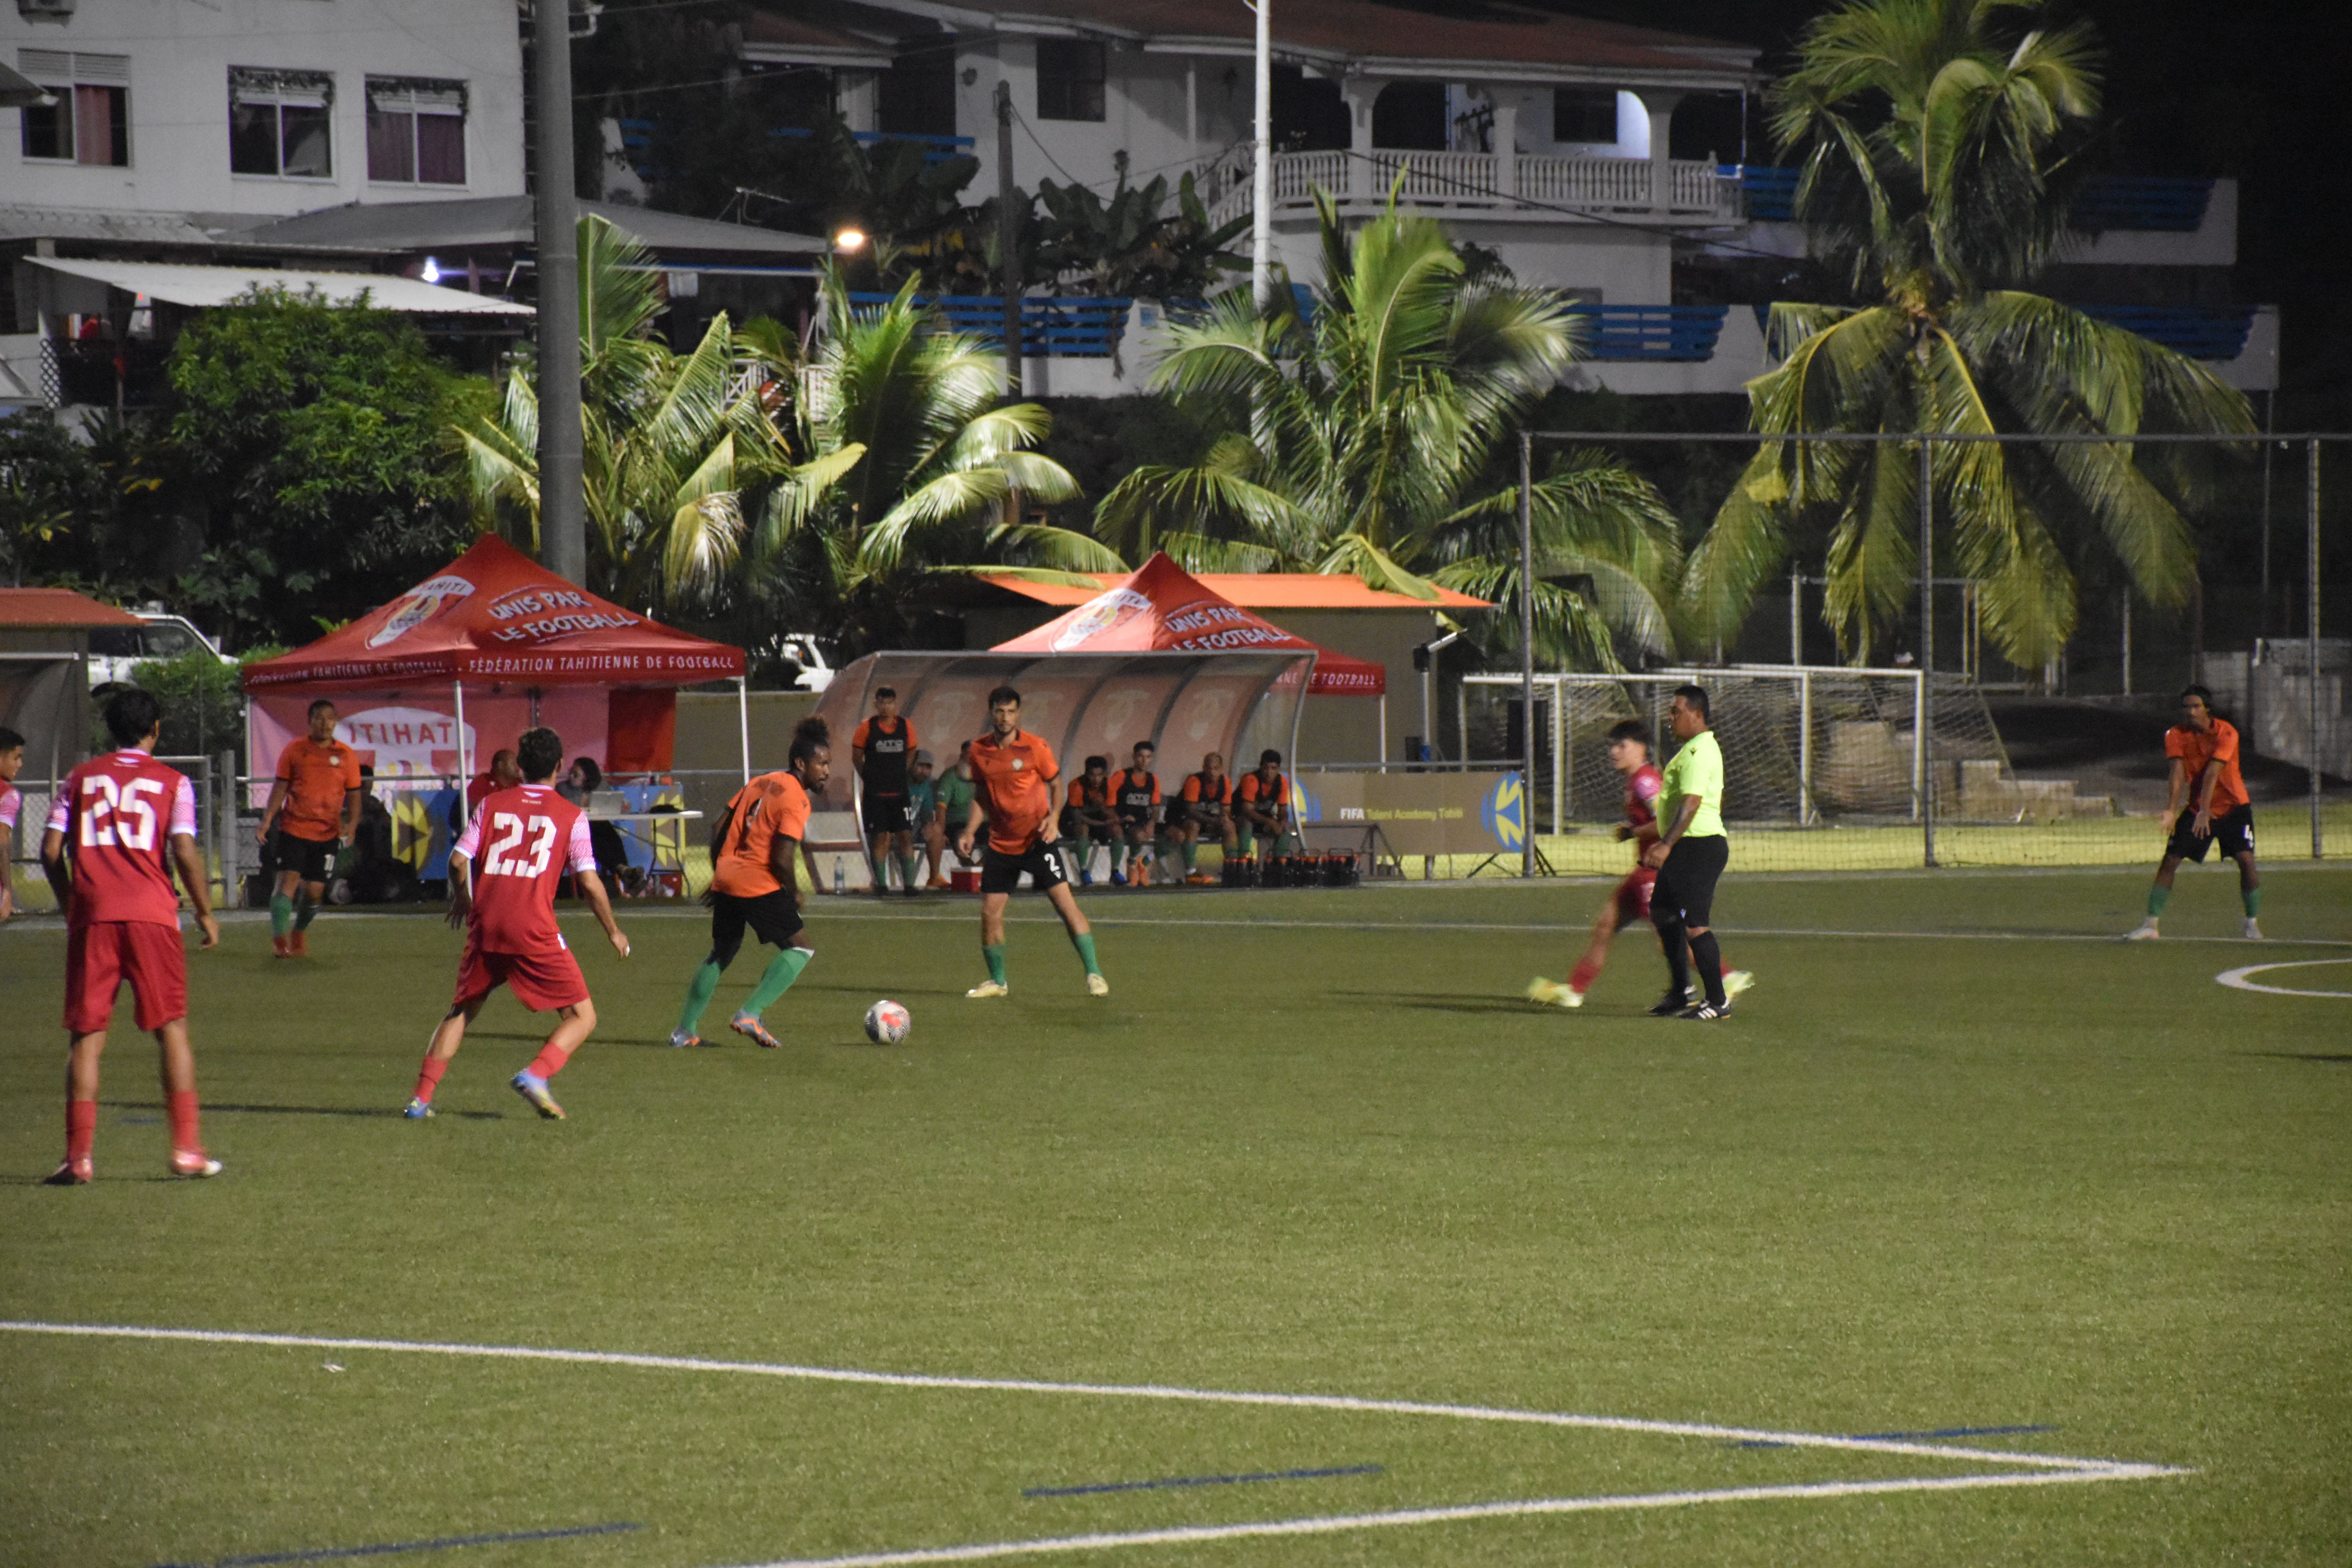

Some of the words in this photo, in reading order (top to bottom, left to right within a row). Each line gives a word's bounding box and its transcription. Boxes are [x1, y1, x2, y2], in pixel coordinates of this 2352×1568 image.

[487, 596, 544, 620] UNIS
[539, 591, 592, 608] PAR
[492, 627, 526, 641] LE
[523, 613, 639, 637] FOOTBALL
[1165, 611, 1210, 632] UNIS
[1207, 607, 1252, 624] PAR
[1197, 628, 1292, 650] FOOTBALL
[470, 657, 554, 673] FÉDÉRATION
[560, 655, 639, 670] TAHITIENNE
[646, 656, 662, 668] DE
[669, 656, 734, 668] FOOTBALL
[1321, 673, 1375, 685] FOOTBALL
[82, 775, 164, 851] 25
[1340, 808, 1365, 820] FIFA
[485, 812, 557, 878] 23
[1044, 853, 1060, 872] 2
